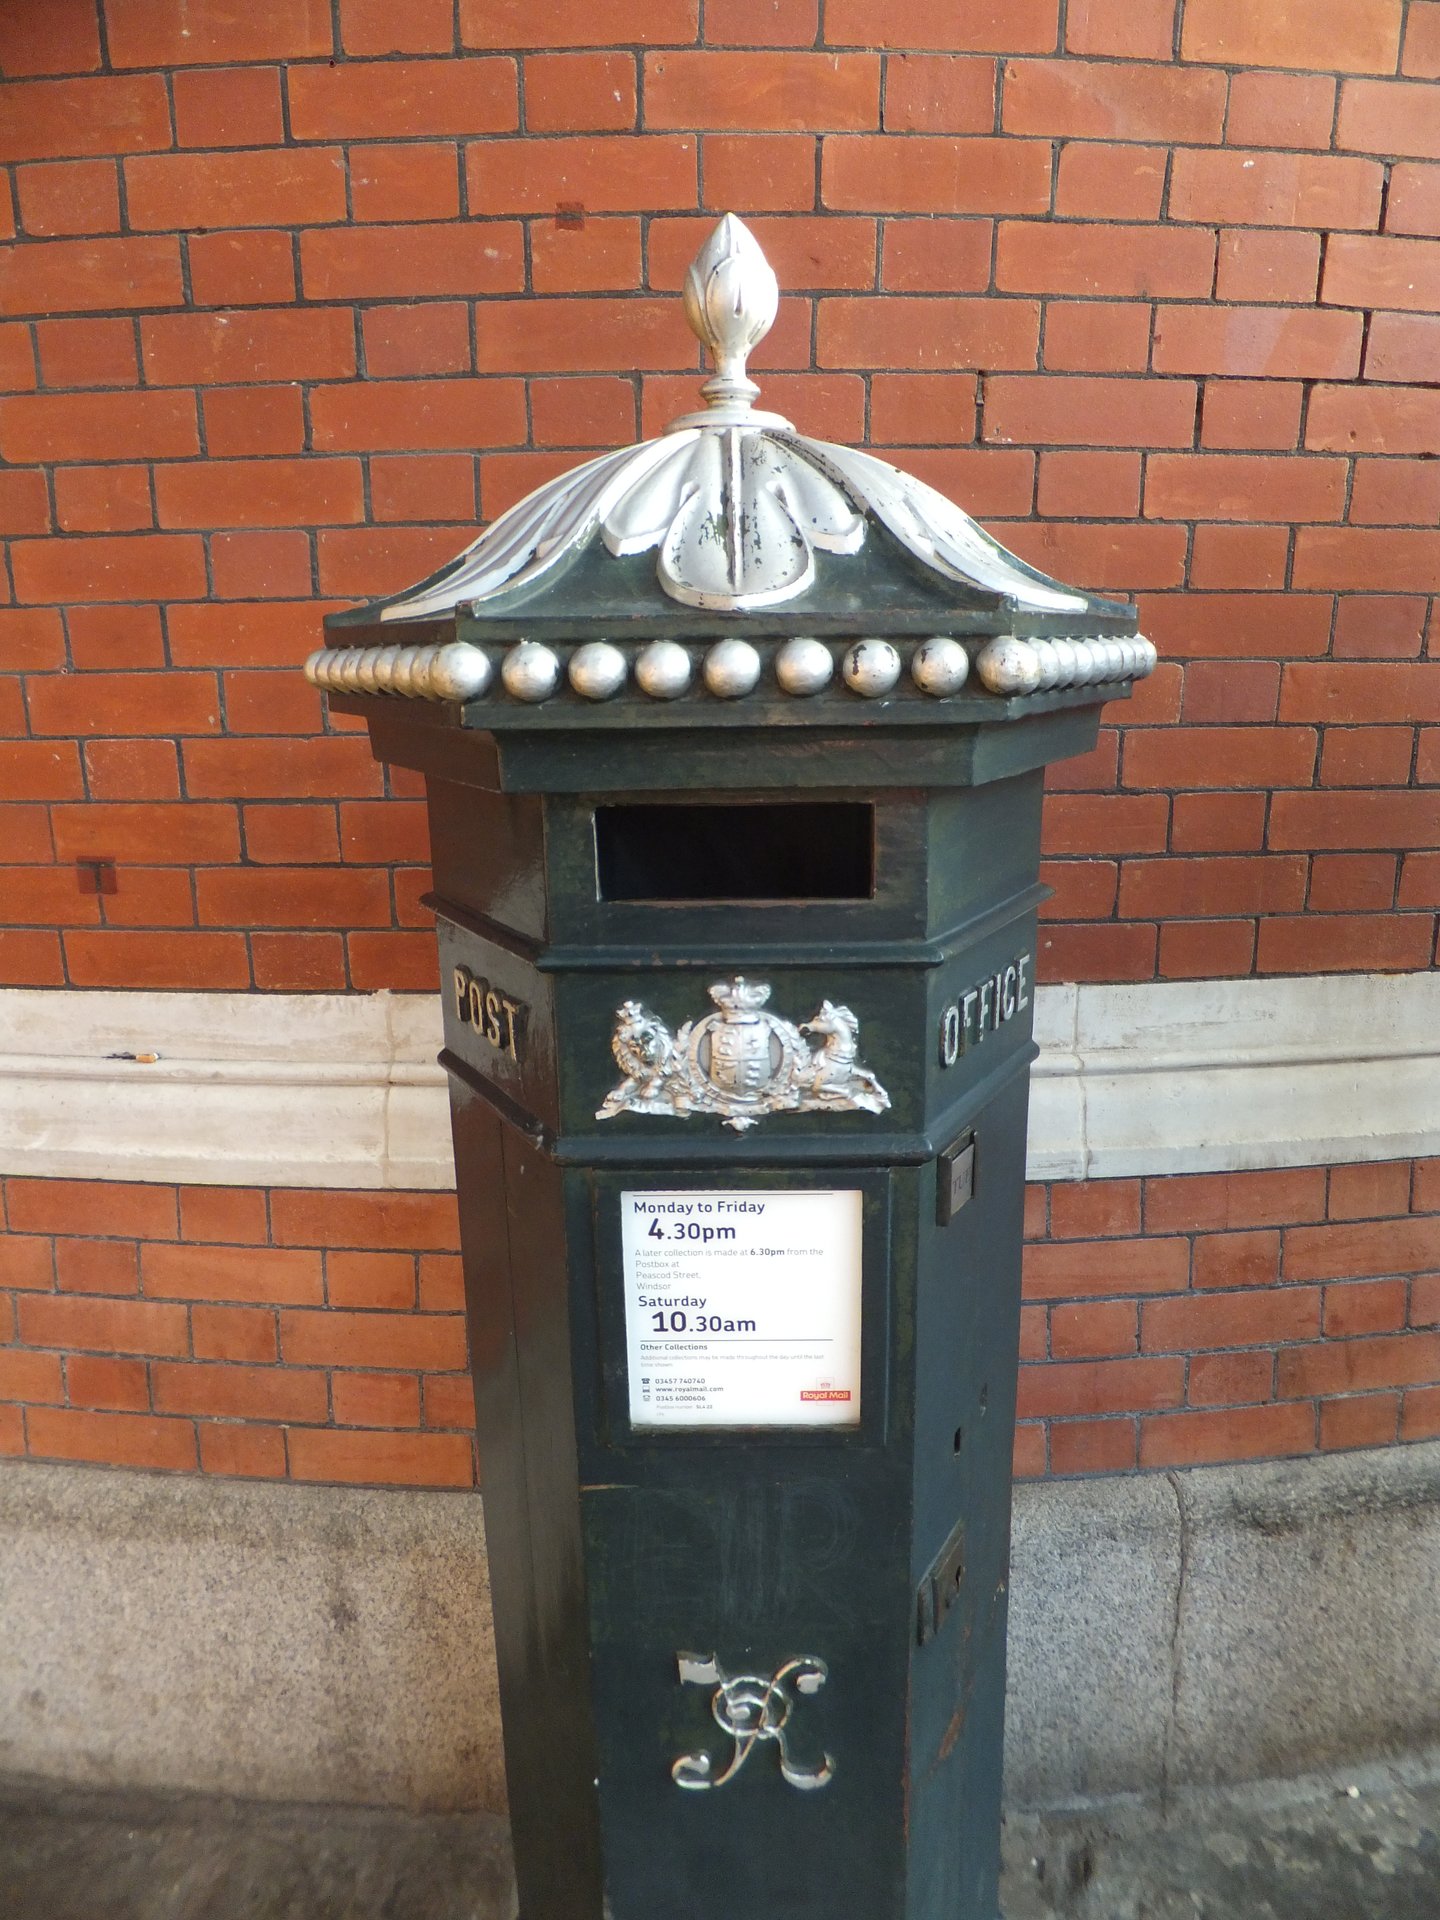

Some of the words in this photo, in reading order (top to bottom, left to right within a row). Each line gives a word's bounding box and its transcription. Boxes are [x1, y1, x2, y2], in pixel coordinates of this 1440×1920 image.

[454, 969, 517, 1061] POST
[945, 954, 1030, 1065] OFFICE
[634, 1201, 693, 1215] Monday
[698, 1202, 713, 1213] to
[717, 1201, 765, 1215] Friday
[648, 1218, 736, 1243] 4.30pm
[642, 1249, 662, 1257] later
[664, 1249, 704, 1257] collection
[714, 1248, 738, 1257] made
[750, 1248, 785, 1257] 6.30pm
[786, 1248, 808, 1256] from
[809, 1248, 824, 1256] the
[635, 1260, 669, 1268] Postbox
[636, 1271, 671, 1279] Peascod
[636, 1282, 671, 1290] Windsor
[638, 1295, 707, 1309] Saturday
[652, 1311, 756, 1333] 10.30am
[640, 1343, 662, 1351] Other
[664, 1343, 708, 1351] Collections
[802, 1392, 827, 1400] Royal
[829, 1391, 848, 1399] Mail
